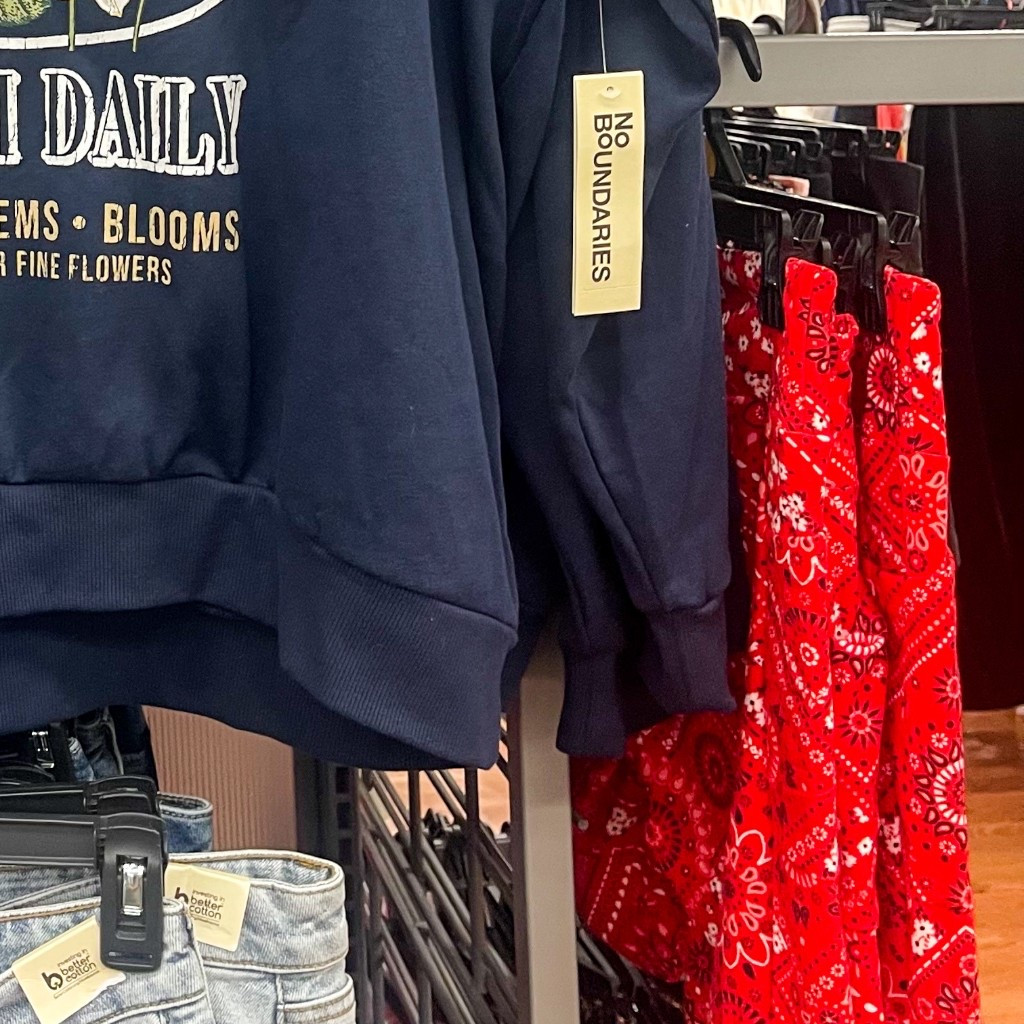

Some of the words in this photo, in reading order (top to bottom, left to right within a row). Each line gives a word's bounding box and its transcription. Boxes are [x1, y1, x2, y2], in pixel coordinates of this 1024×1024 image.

[39, 67, 247, 177] DAILY
[591, 113, 613, 283] BOUNDARIES
[103, 202, 240, 253] BLOOMS
[16, 250, 60, 280] FINE
[69, 253, 172, 286] FLOWERS
[189, 904, 222, 920] cotton
[191, 895, 223, 911] better
[60, 954, 90, 976] better
[66, 962, 97, 983] cotton
